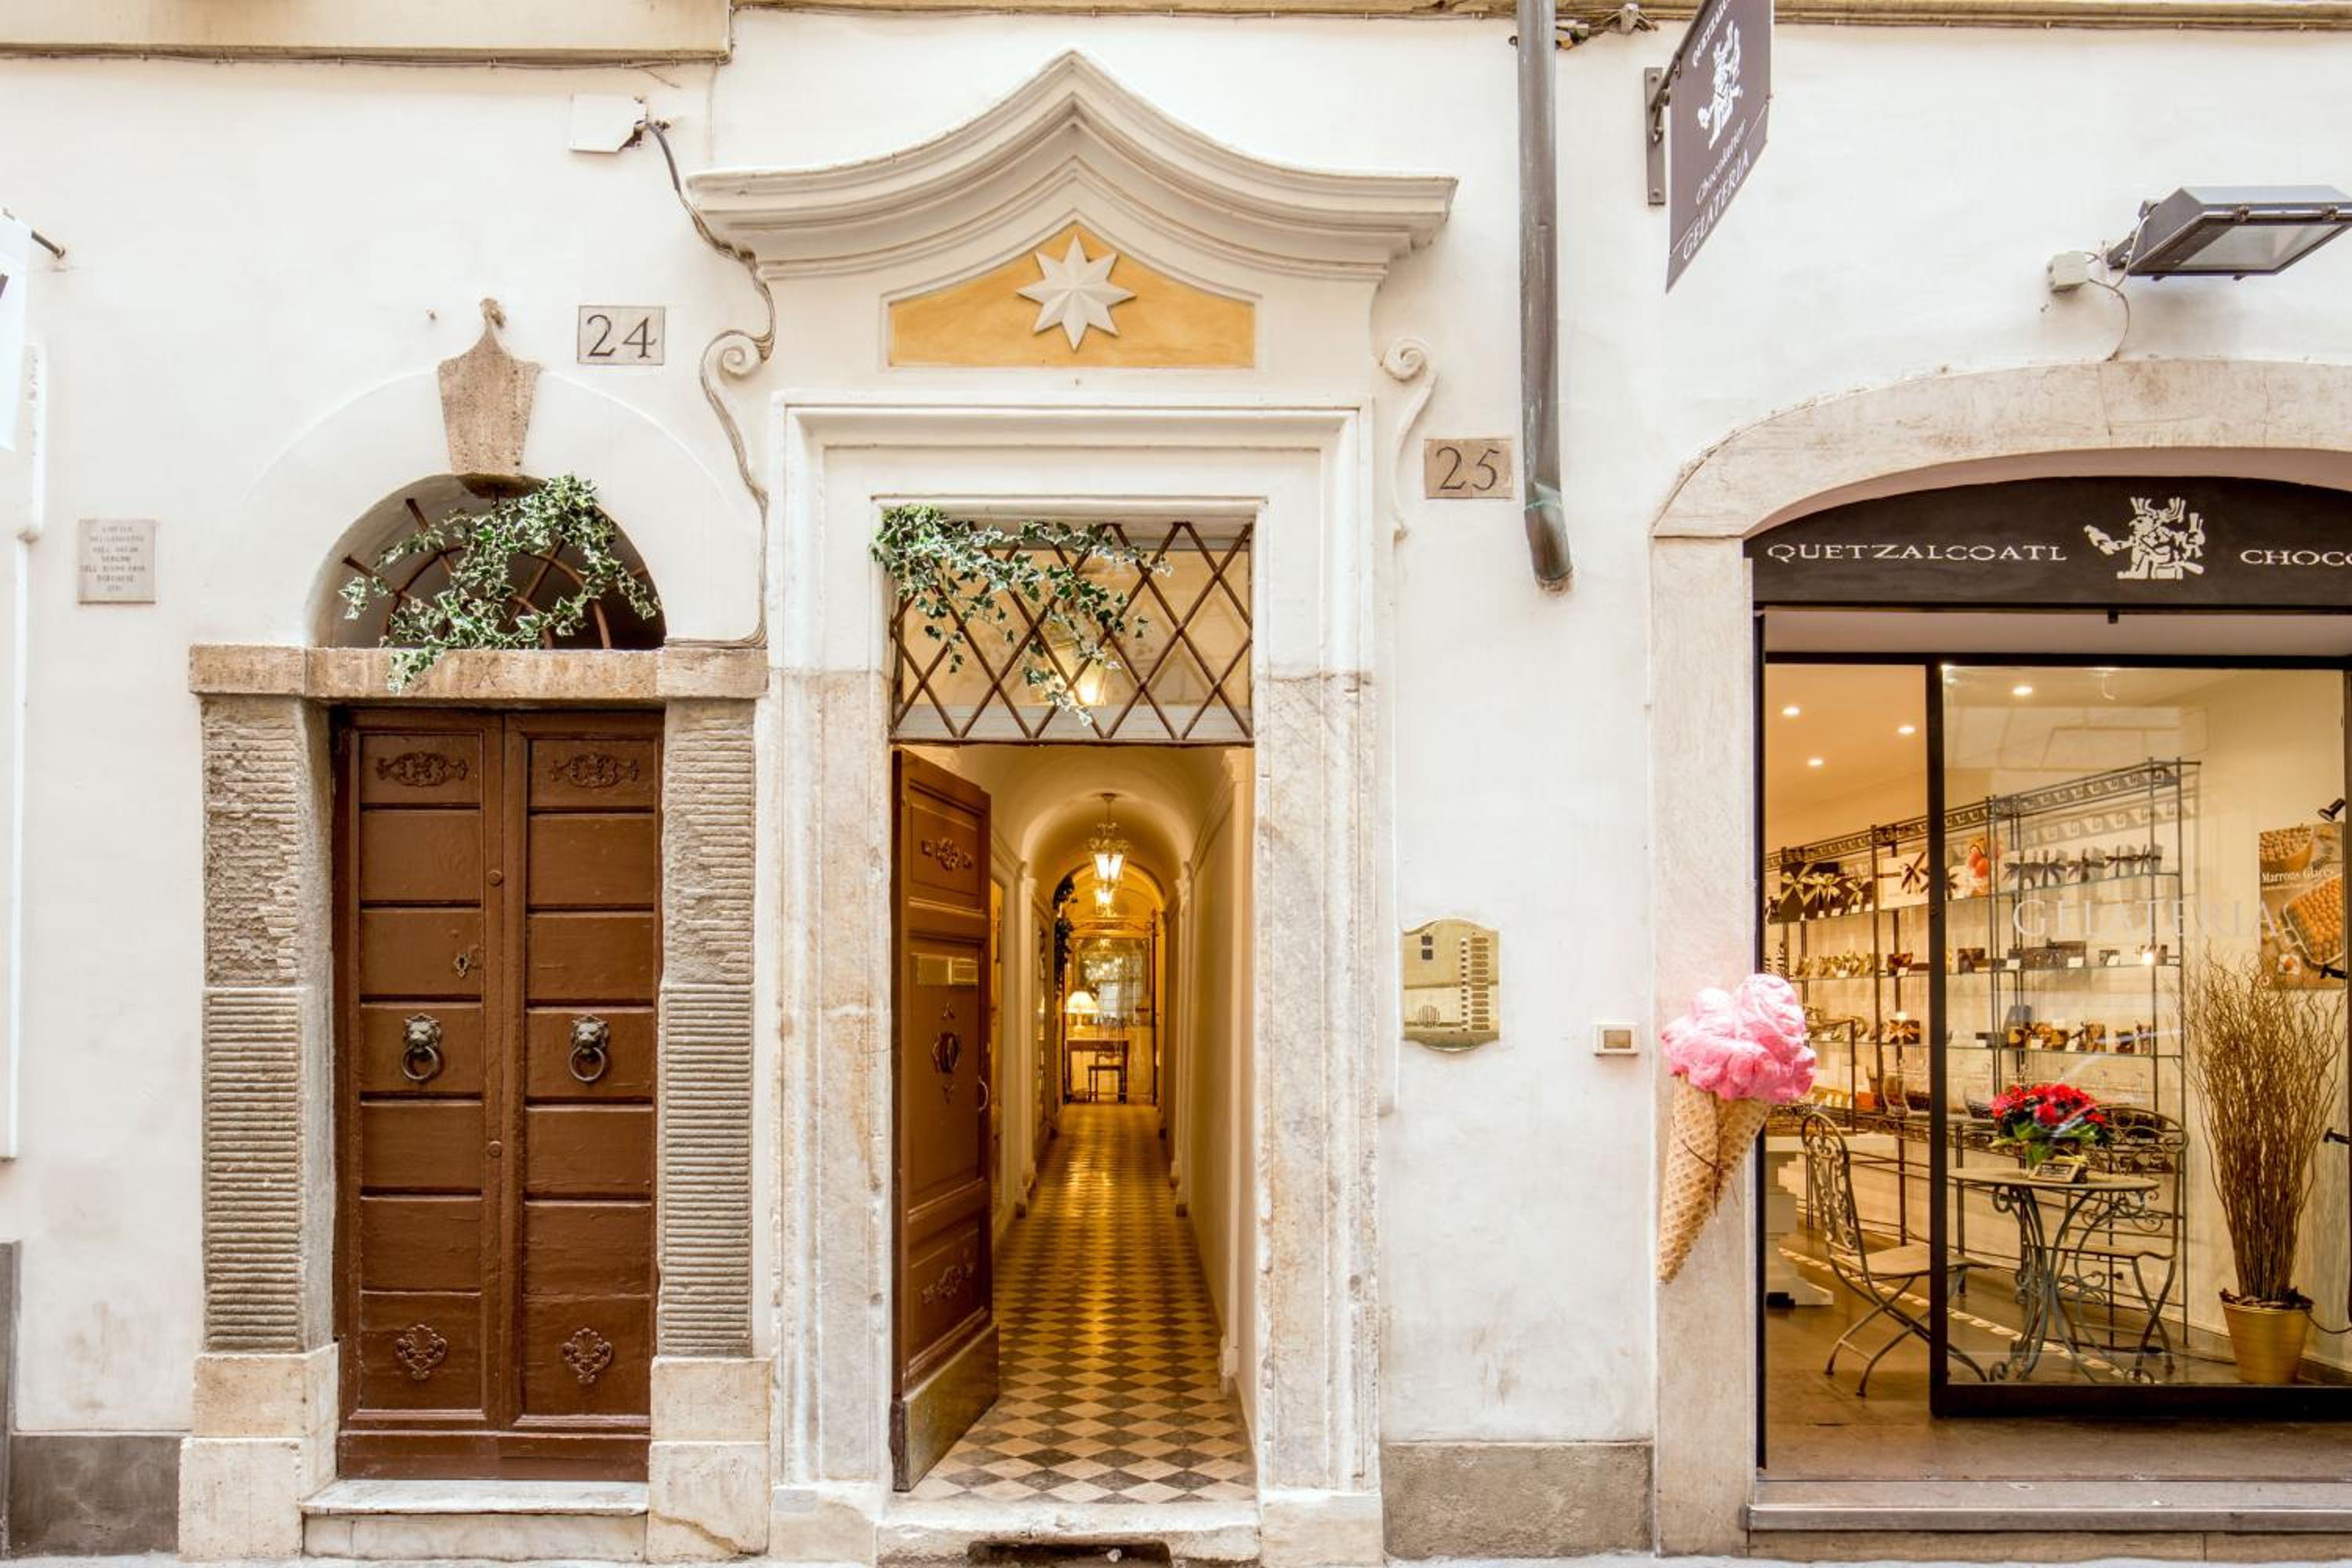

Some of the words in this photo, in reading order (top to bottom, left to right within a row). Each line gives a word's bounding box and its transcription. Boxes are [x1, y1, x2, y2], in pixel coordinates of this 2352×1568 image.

[1683, 147, 1749, 260] GELATERIA
[586, 314, 658, 358] 24
[1436, 446, 1501, 491] 25
[1766, 543, 2068, 563] QUETZALCOATL
[2238, 549, 2352, 568] CHOC
